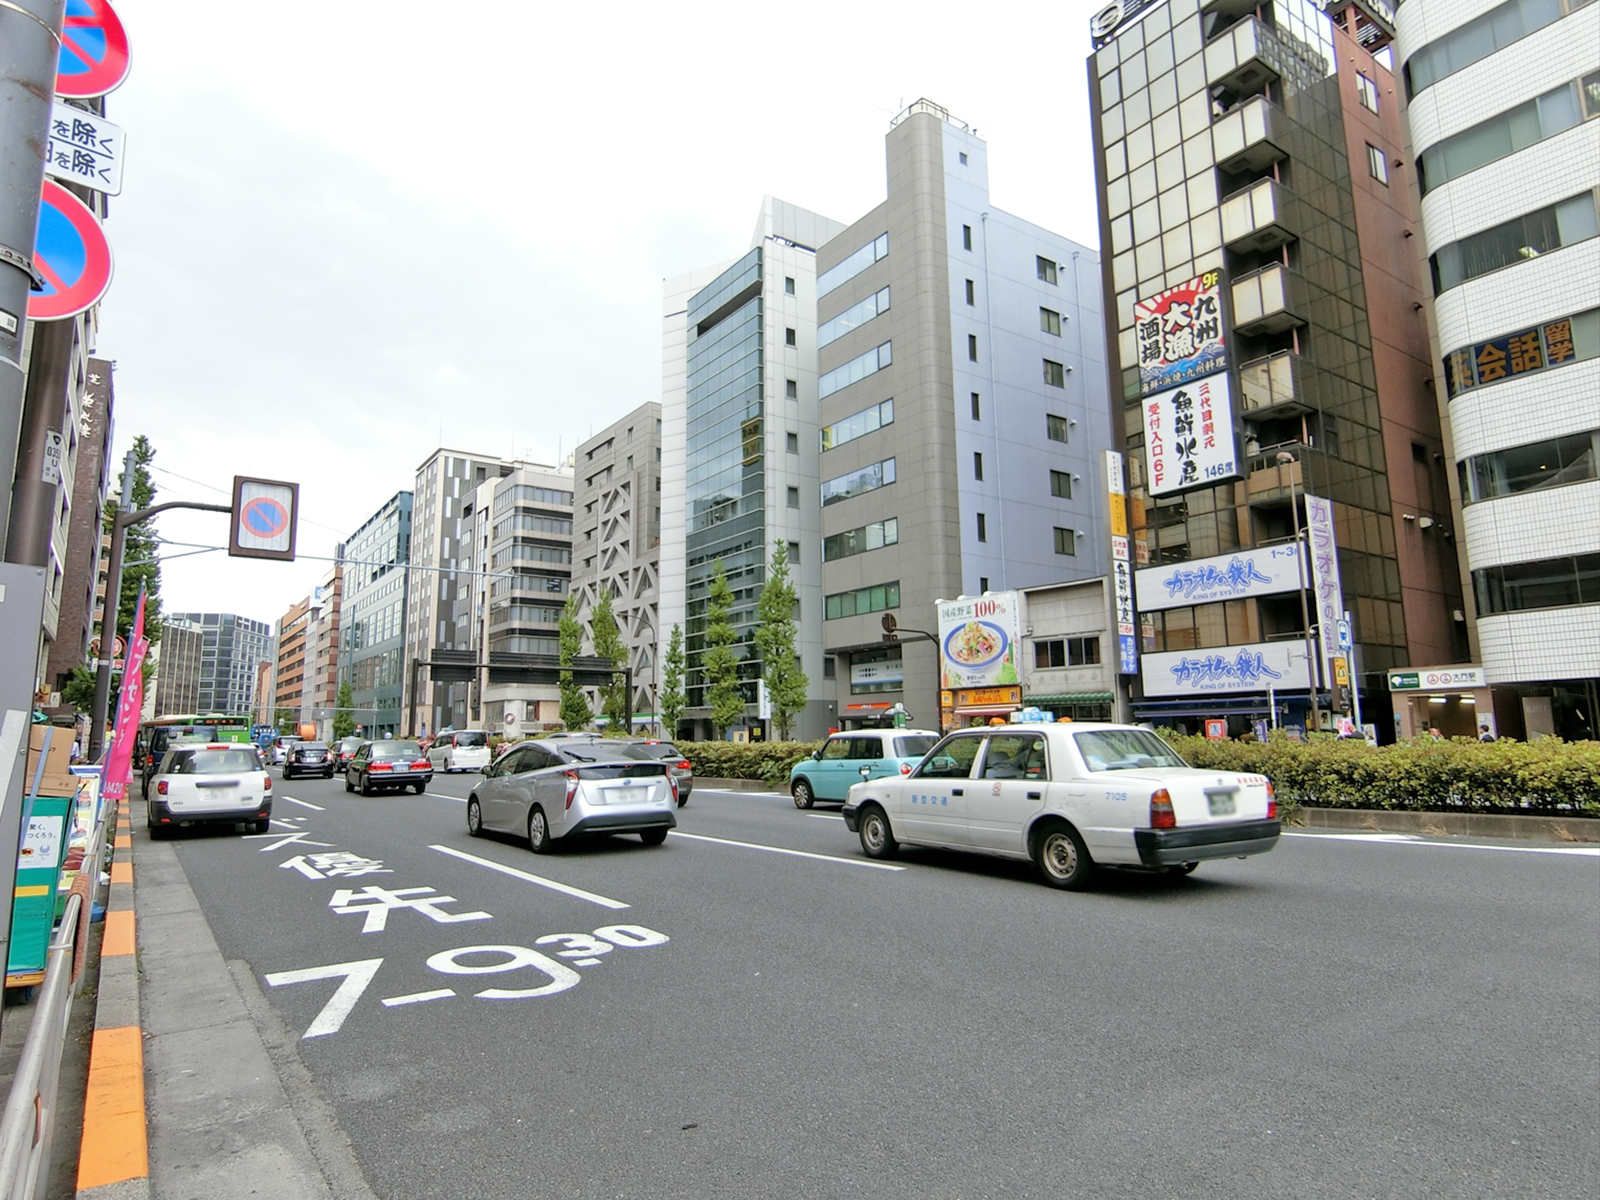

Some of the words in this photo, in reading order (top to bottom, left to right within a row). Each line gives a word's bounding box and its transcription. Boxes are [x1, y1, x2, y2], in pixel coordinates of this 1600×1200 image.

[52, 118, 114, 154] を除く
[1202, 271, 1218, 289] 9F
[1161, 300, 1196, 364] 大漁
[1194, 294, 1219, 344] 九州
[1140, 316, 1163, 364] 酒場
[1148, 402, 1165, 488] 受付入口6F
[1204, 461, 1234, 480] 146席
[1163, 556, 1273, 599] カラオケの鉄人
[1193, 591, 1208, 600] KING
[1209, 590, 1218, 599] OF
[1219, 587, 1246, 598] SYSTEM
[941, 604, 973, 619] 国産野菜
[974, 599, 1007, 618] 100%
[1169, 647, 1282, 688] カラオケの鉄人
[1453, 672, 1477, 680] 大門駅
[1217, 682, 1226, 690] OF
[1227, 680, 1255, 689] SYSTEM
[1105, 792, 1127, 802] 7105
